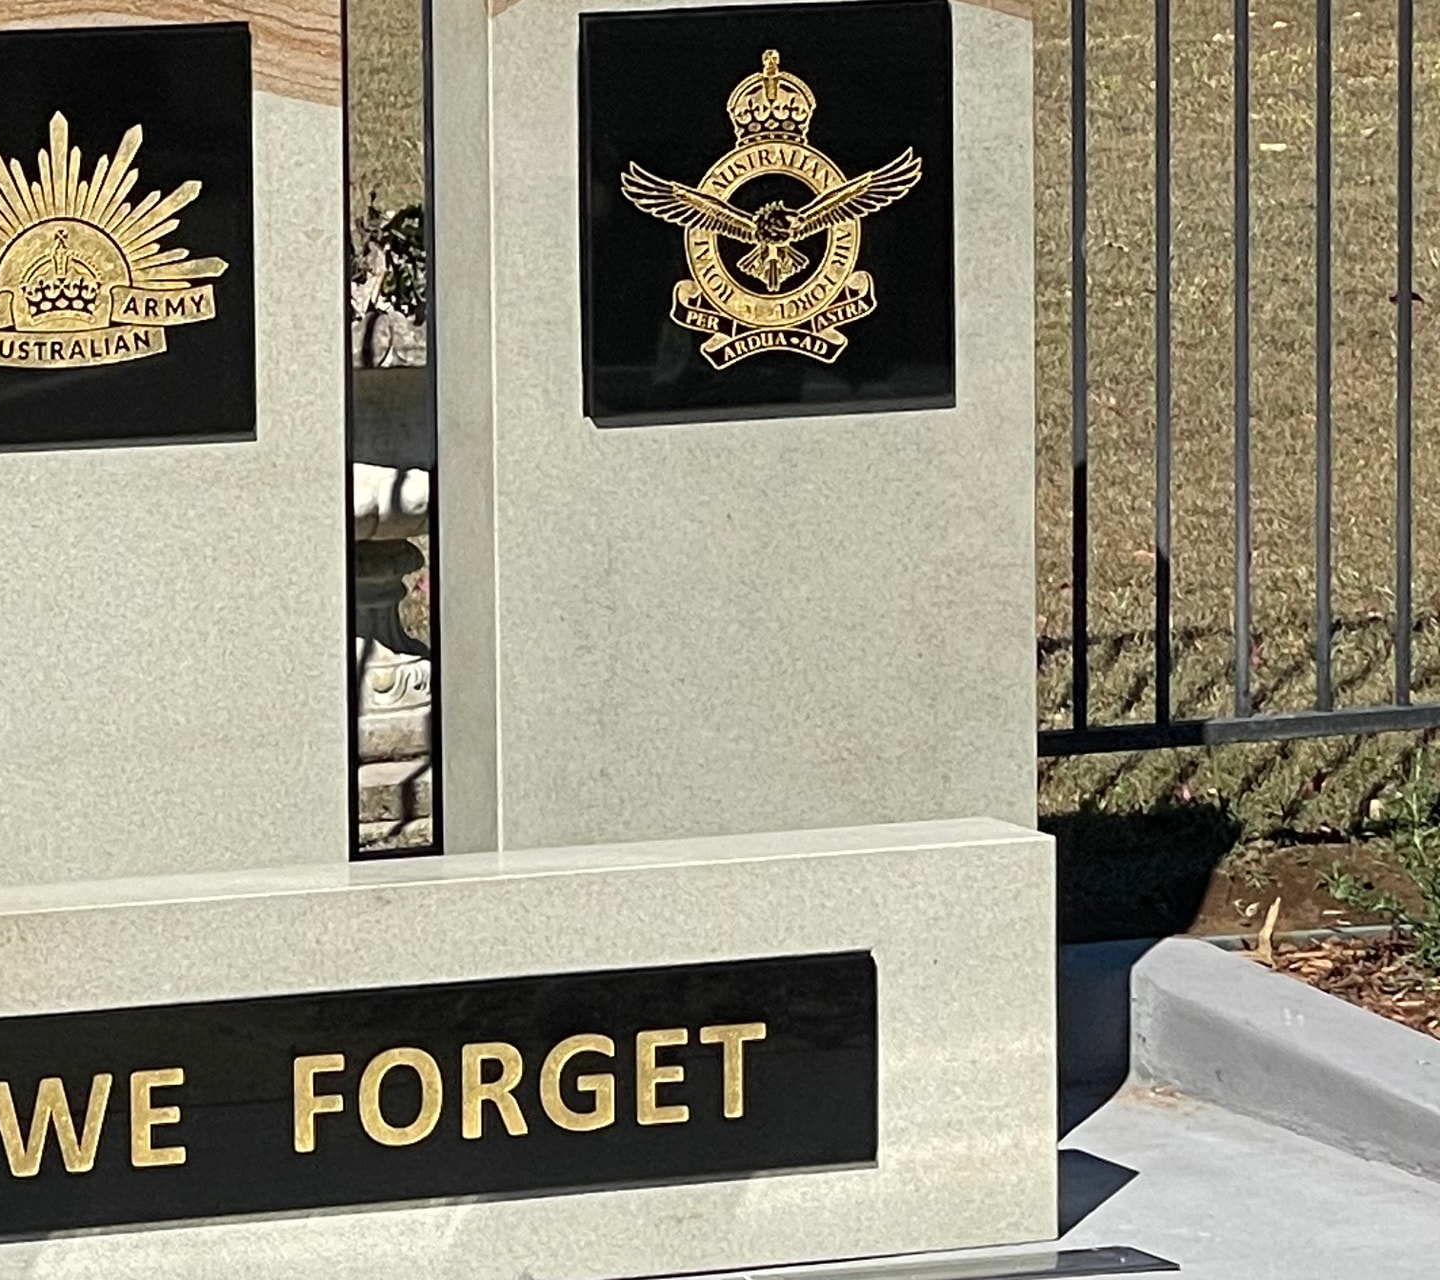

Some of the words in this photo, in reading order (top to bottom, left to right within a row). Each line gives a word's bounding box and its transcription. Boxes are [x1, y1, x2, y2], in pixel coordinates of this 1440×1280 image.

[711, 148, 837, 193] AUSTRALIAN
[122, 293, 207, 317] ARMY
[685, 311, 720, 332] PER
[816, 299, 871, 331] ASTRA
[291, 1021, 768, 1154] FORGET
